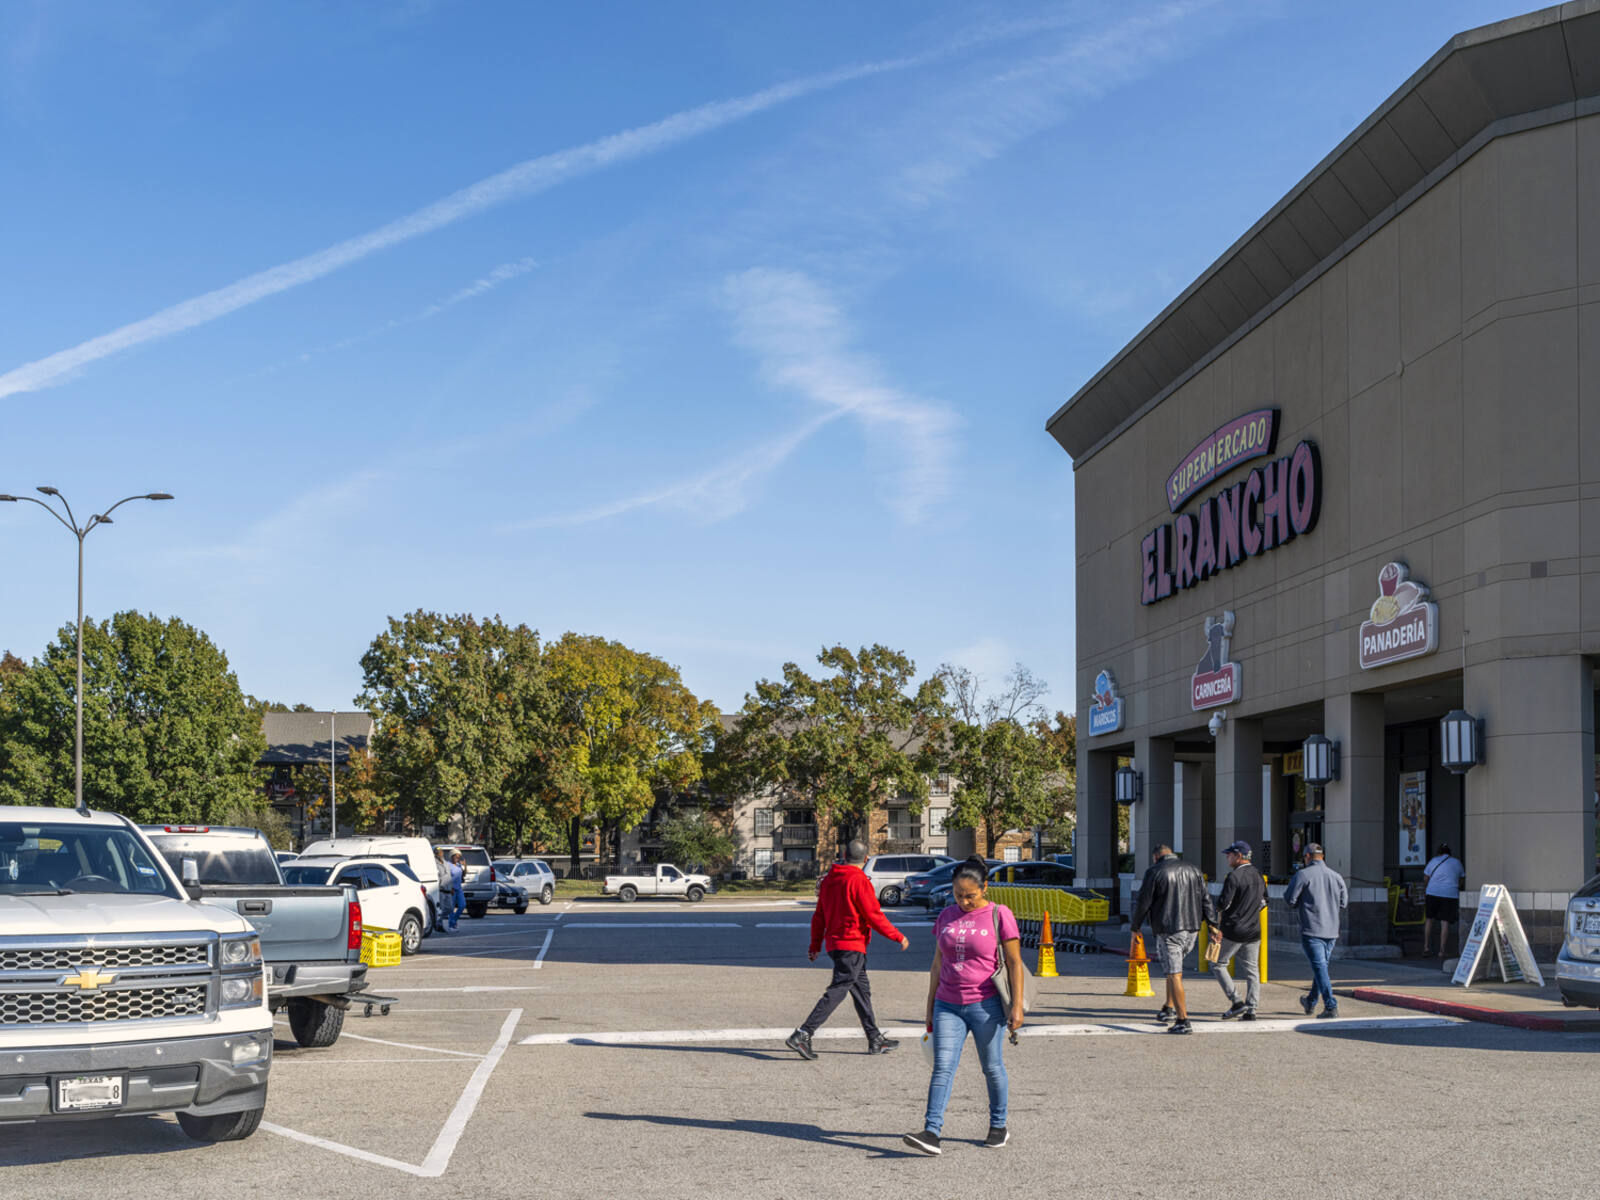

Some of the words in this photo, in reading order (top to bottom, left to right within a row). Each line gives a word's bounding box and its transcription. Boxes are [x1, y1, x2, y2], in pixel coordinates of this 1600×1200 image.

[1171, 417, 1267, 501] SUPERMERCADO
[1141, 523, 1173, 606] EL
[1175, 440, 1318, 589] RANCHO
[1363, 617, 1425, 656] PANADERÍA
[1195, 673, 1232, 701] CARNICERÍA
